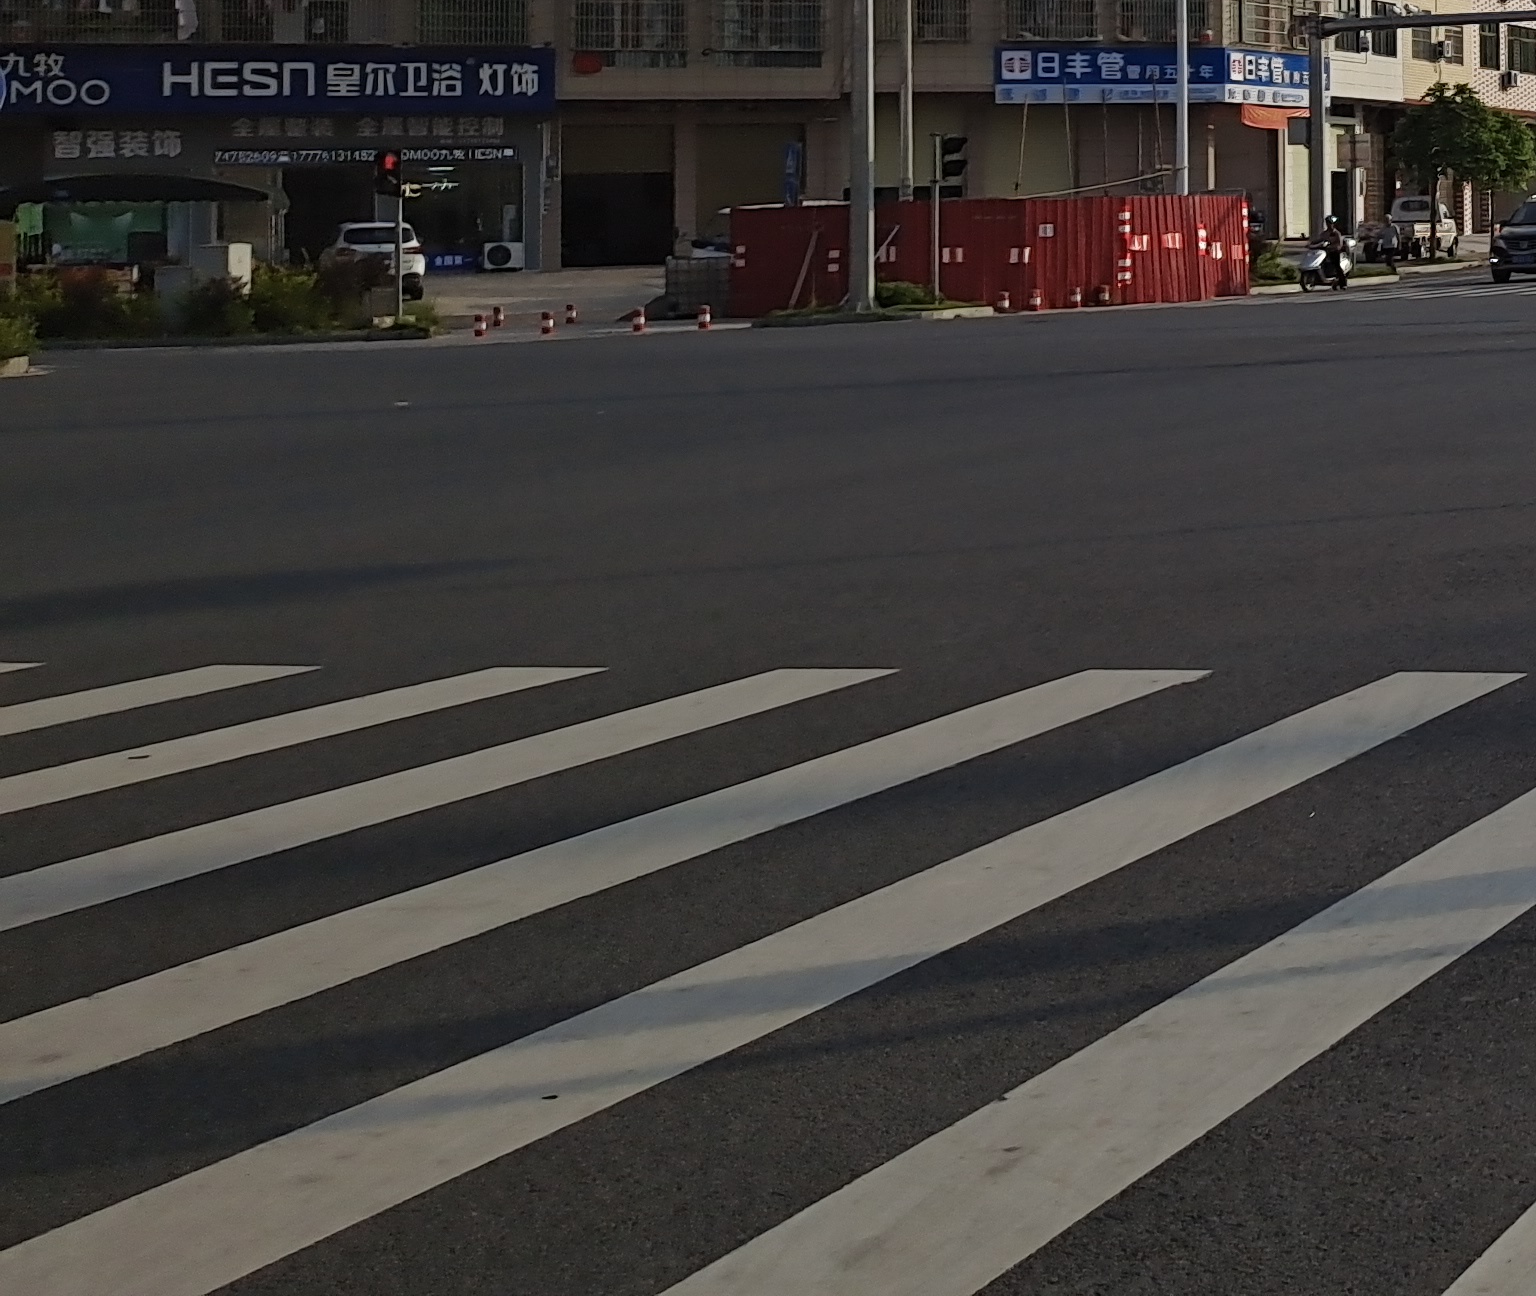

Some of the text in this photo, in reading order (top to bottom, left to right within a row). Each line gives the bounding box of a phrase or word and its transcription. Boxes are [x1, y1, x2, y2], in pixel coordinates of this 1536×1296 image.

[326, 62, 463, 97] 皇尔卫浴
[478, 63, 540, 97] 灯饰
[1037, 52, 1125, 80] 日丰管
[53, 130, 182, 159] 智强装饰
